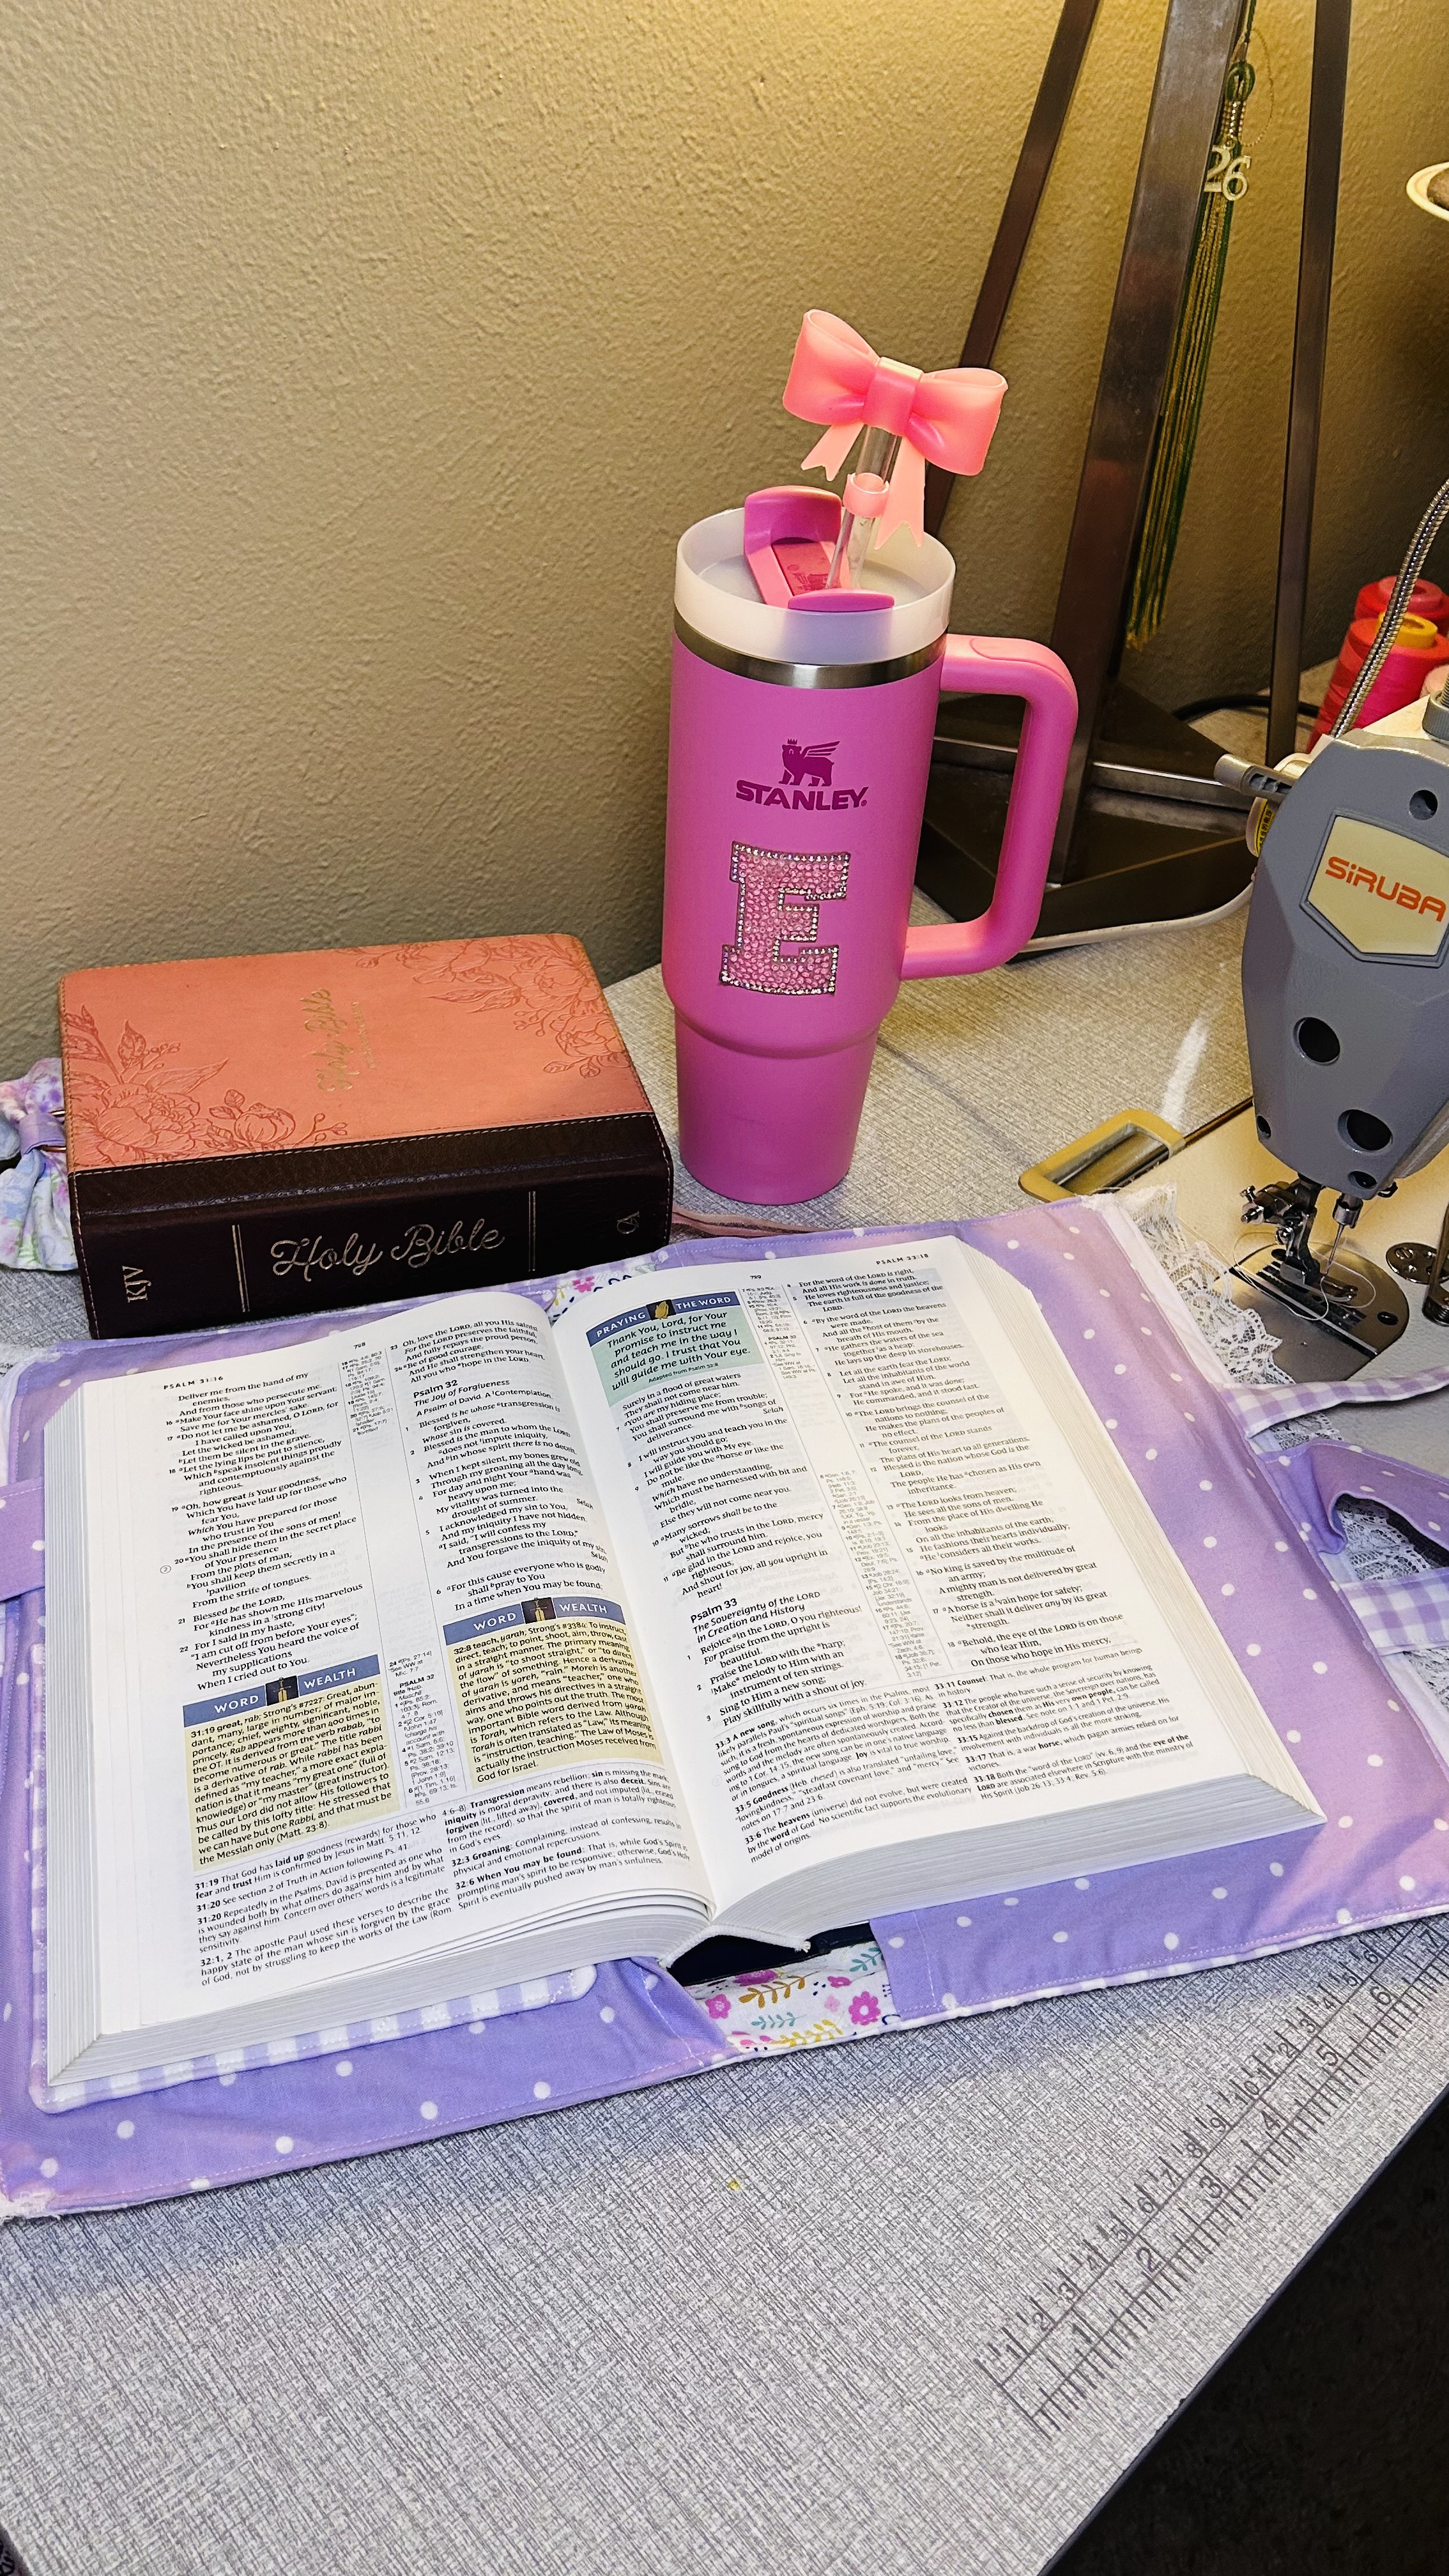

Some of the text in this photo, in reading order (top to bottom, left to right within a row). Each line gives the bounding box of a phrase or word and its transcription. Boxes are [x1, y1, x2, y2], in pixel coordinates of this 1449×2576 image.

[1204, 144, 1251, 201] 26
[735, 779, 869, 811] STANLEY
[719, 841, 851, 995] E
[300, 988, 360, 1091] Holy Bible
[270, 1217, 506, 1282] Holy Bible
[875, 1257, 903, 1265] PSALM
[122, 1266, 152, 1303] KJV
[596, 1296, 732, 1338] PRAYING THE WORD
[607, 1312, 728, 1348] Thank You, Lord, for Your
[353, 1341, 365, 1349] 728
[611, 1353, 630, 1368] and
[631, 1344, 659, 1359] teach
[660, 1340, 677, 1349] me
[678, 1337, 689, 1345] in
[691, 1334, 708, 1342] the
[709, 1330, 732, 1339] way
[614, 1335, 655, 1358] promise
[668, 1322, 709, 1337] instruct
[710, 1321, 726, 1330] me
[611, 1348, 750, 1391] will guide me with Your eye.
[614, 1357, 648, 1379] should
[671, 1344, 698, 1356] trust
[698, 1340, 721, 1351] that
[648, 1371, 673, 1383] Adapted
[164, 1380, 195, 1390] PSALM
[178, 1392, 208, 1402] Deliver
[263, 1377, 284, 1388] hand
[413, 1379, 458, 1399] Psalm 32
[413, 1380, 510, 1407] The Joy of Forgiveness
[180, 1424, 200, 1432] Save
[230, 1416, 252, 1424] Your
[473, 1603, 608, 1631] WORD WEALTH
[690, 1598, 737, 1624] Psalm 33
[693, 1622, 710, 1634] The
[710, 1602, 767, 1627] Sovereignty
[768, 1598, 777, 1608] of
[779, 1596, 795, 1605] the
[697, 1604, 805, 1644] in Creation and History
[709, 1668, 737, 1685] Praise
[737, 1662, 753, 1673] the
[778, 1648, 800, 1659] with
[801, 1646, 816, 1654] the
[985, 1655, 1010, 1665] those
[1009, 1652, 1030, 1660] who
[1029, 1648, 1054, 1657] hope
[1063, 1643, 1081, 1651] His
[1081, 1637, 1111, 1648] mercy,
[214, 1667, 356, 1713] WORD WEALTH
[719, 1702, 740, 1716] Sing
[740, 1698, 750, 1706] to
[751, 1690, 773, 1702] Him
[780, 1682, 799, 1692] new
[801, 1676, 826, 1687] song;
[723, 1713, 741, 1726] Play
[743, 1698, 782, 1717] skillfully
[782, 1692, 804, 1703] with
[812, 1683, 839, 1696] shout
[839, 1681, 850, 1690] of
[190, 1726, 215, 1738] 31:19
[217, 1719, 243, 1733] great,
[263, 1703, 298, 1719] Strong's
[326, 1689, 352, 1700] Great,
[353, 1682, 378, 1693] abun-
[965, 1753, 986, 1763] 33:17
[988, 1751, 1006, 1759] That
[1038, 1740, 1063, 1749] horse,
[1062, 1733, 1085, 1744] which
[1087, 1729, 1109, 1740] pagan
[1110, 1724, 1135, 1734] armies
[1136, 1719, 1157, 1729] relied
[1059, 2282, 1076, 2300] 3
[1137, 2197, 1155, 2213] 6
[1186, 2143, 1202, 2158] 8
[1210, 2117, 1226, 2133] 9
[1278, 2043, 1295, 2058] 2
[1300, 2018, 1316, 2034] 3
[1322, 1998, 1337, 2011] 4
[1342, 1972, 1359, 1987] 5
[1363, 1950, 1379, 1964] 6
[1073, 1929, 1439, 2344] 1 2 3 4 5 6 7
